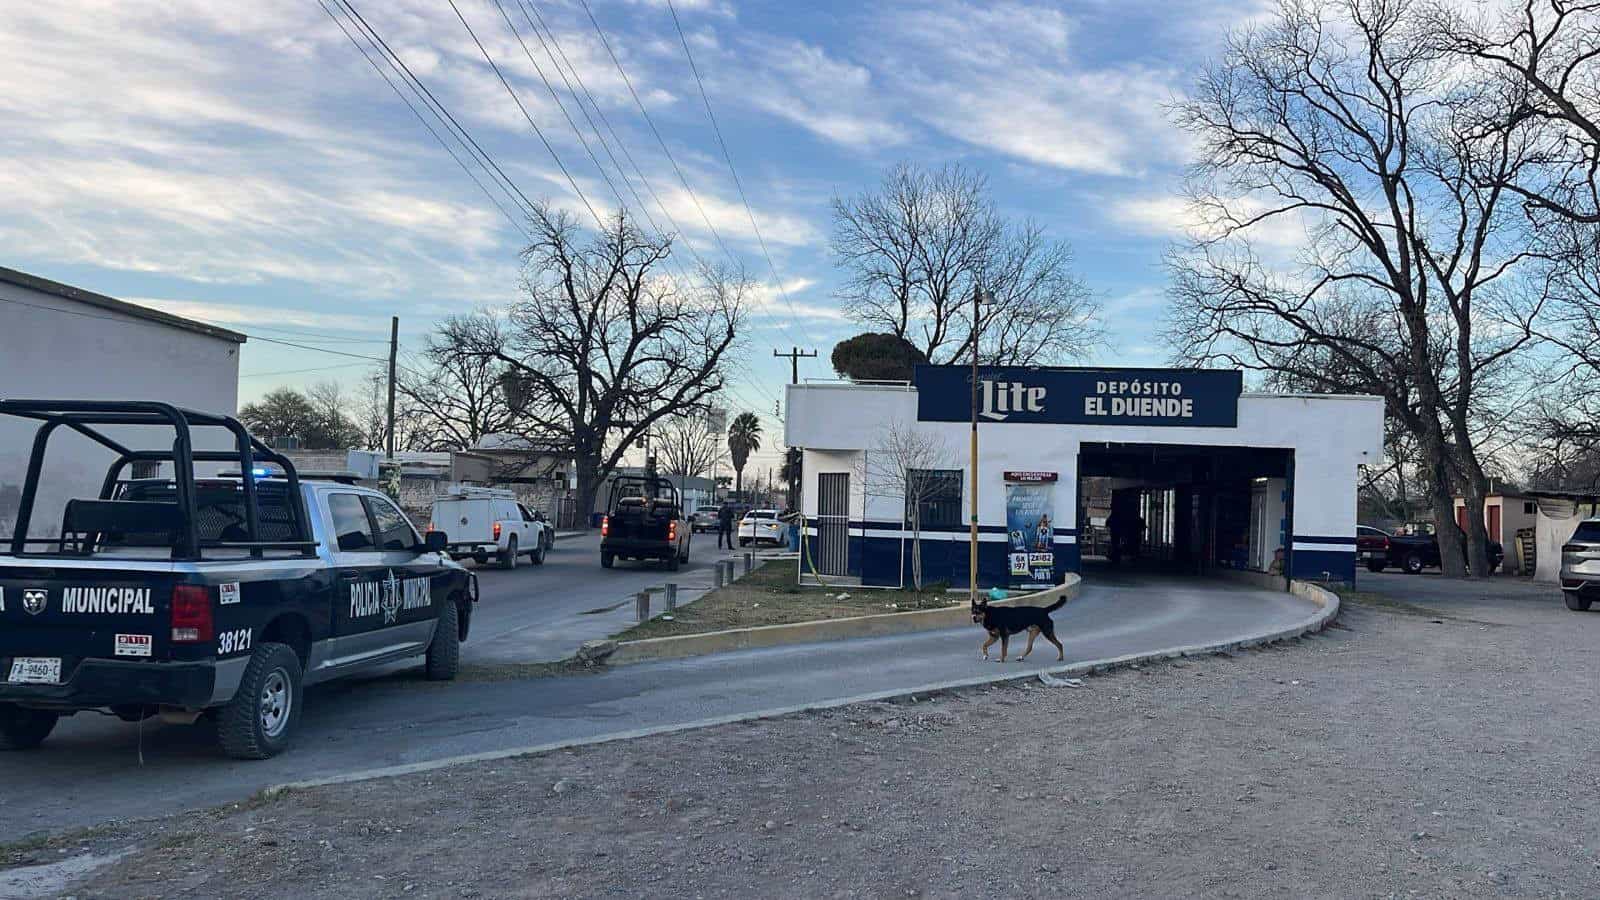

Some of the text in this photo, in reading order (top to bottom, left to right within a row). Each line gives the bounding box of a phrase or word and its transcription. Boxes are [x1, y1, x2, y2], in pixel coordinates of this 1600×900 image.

[979, 380, 1047, 420] Lite
[1096, 379, 1182, 395] DEPÓSITO
[1084, 397, 1193, 417] EL DUENDE
[62, 587, 155, 614] MUNICIPAL
[350, 581, 380, 618] POLICIA
[217, 627, 252, 655] 38121
